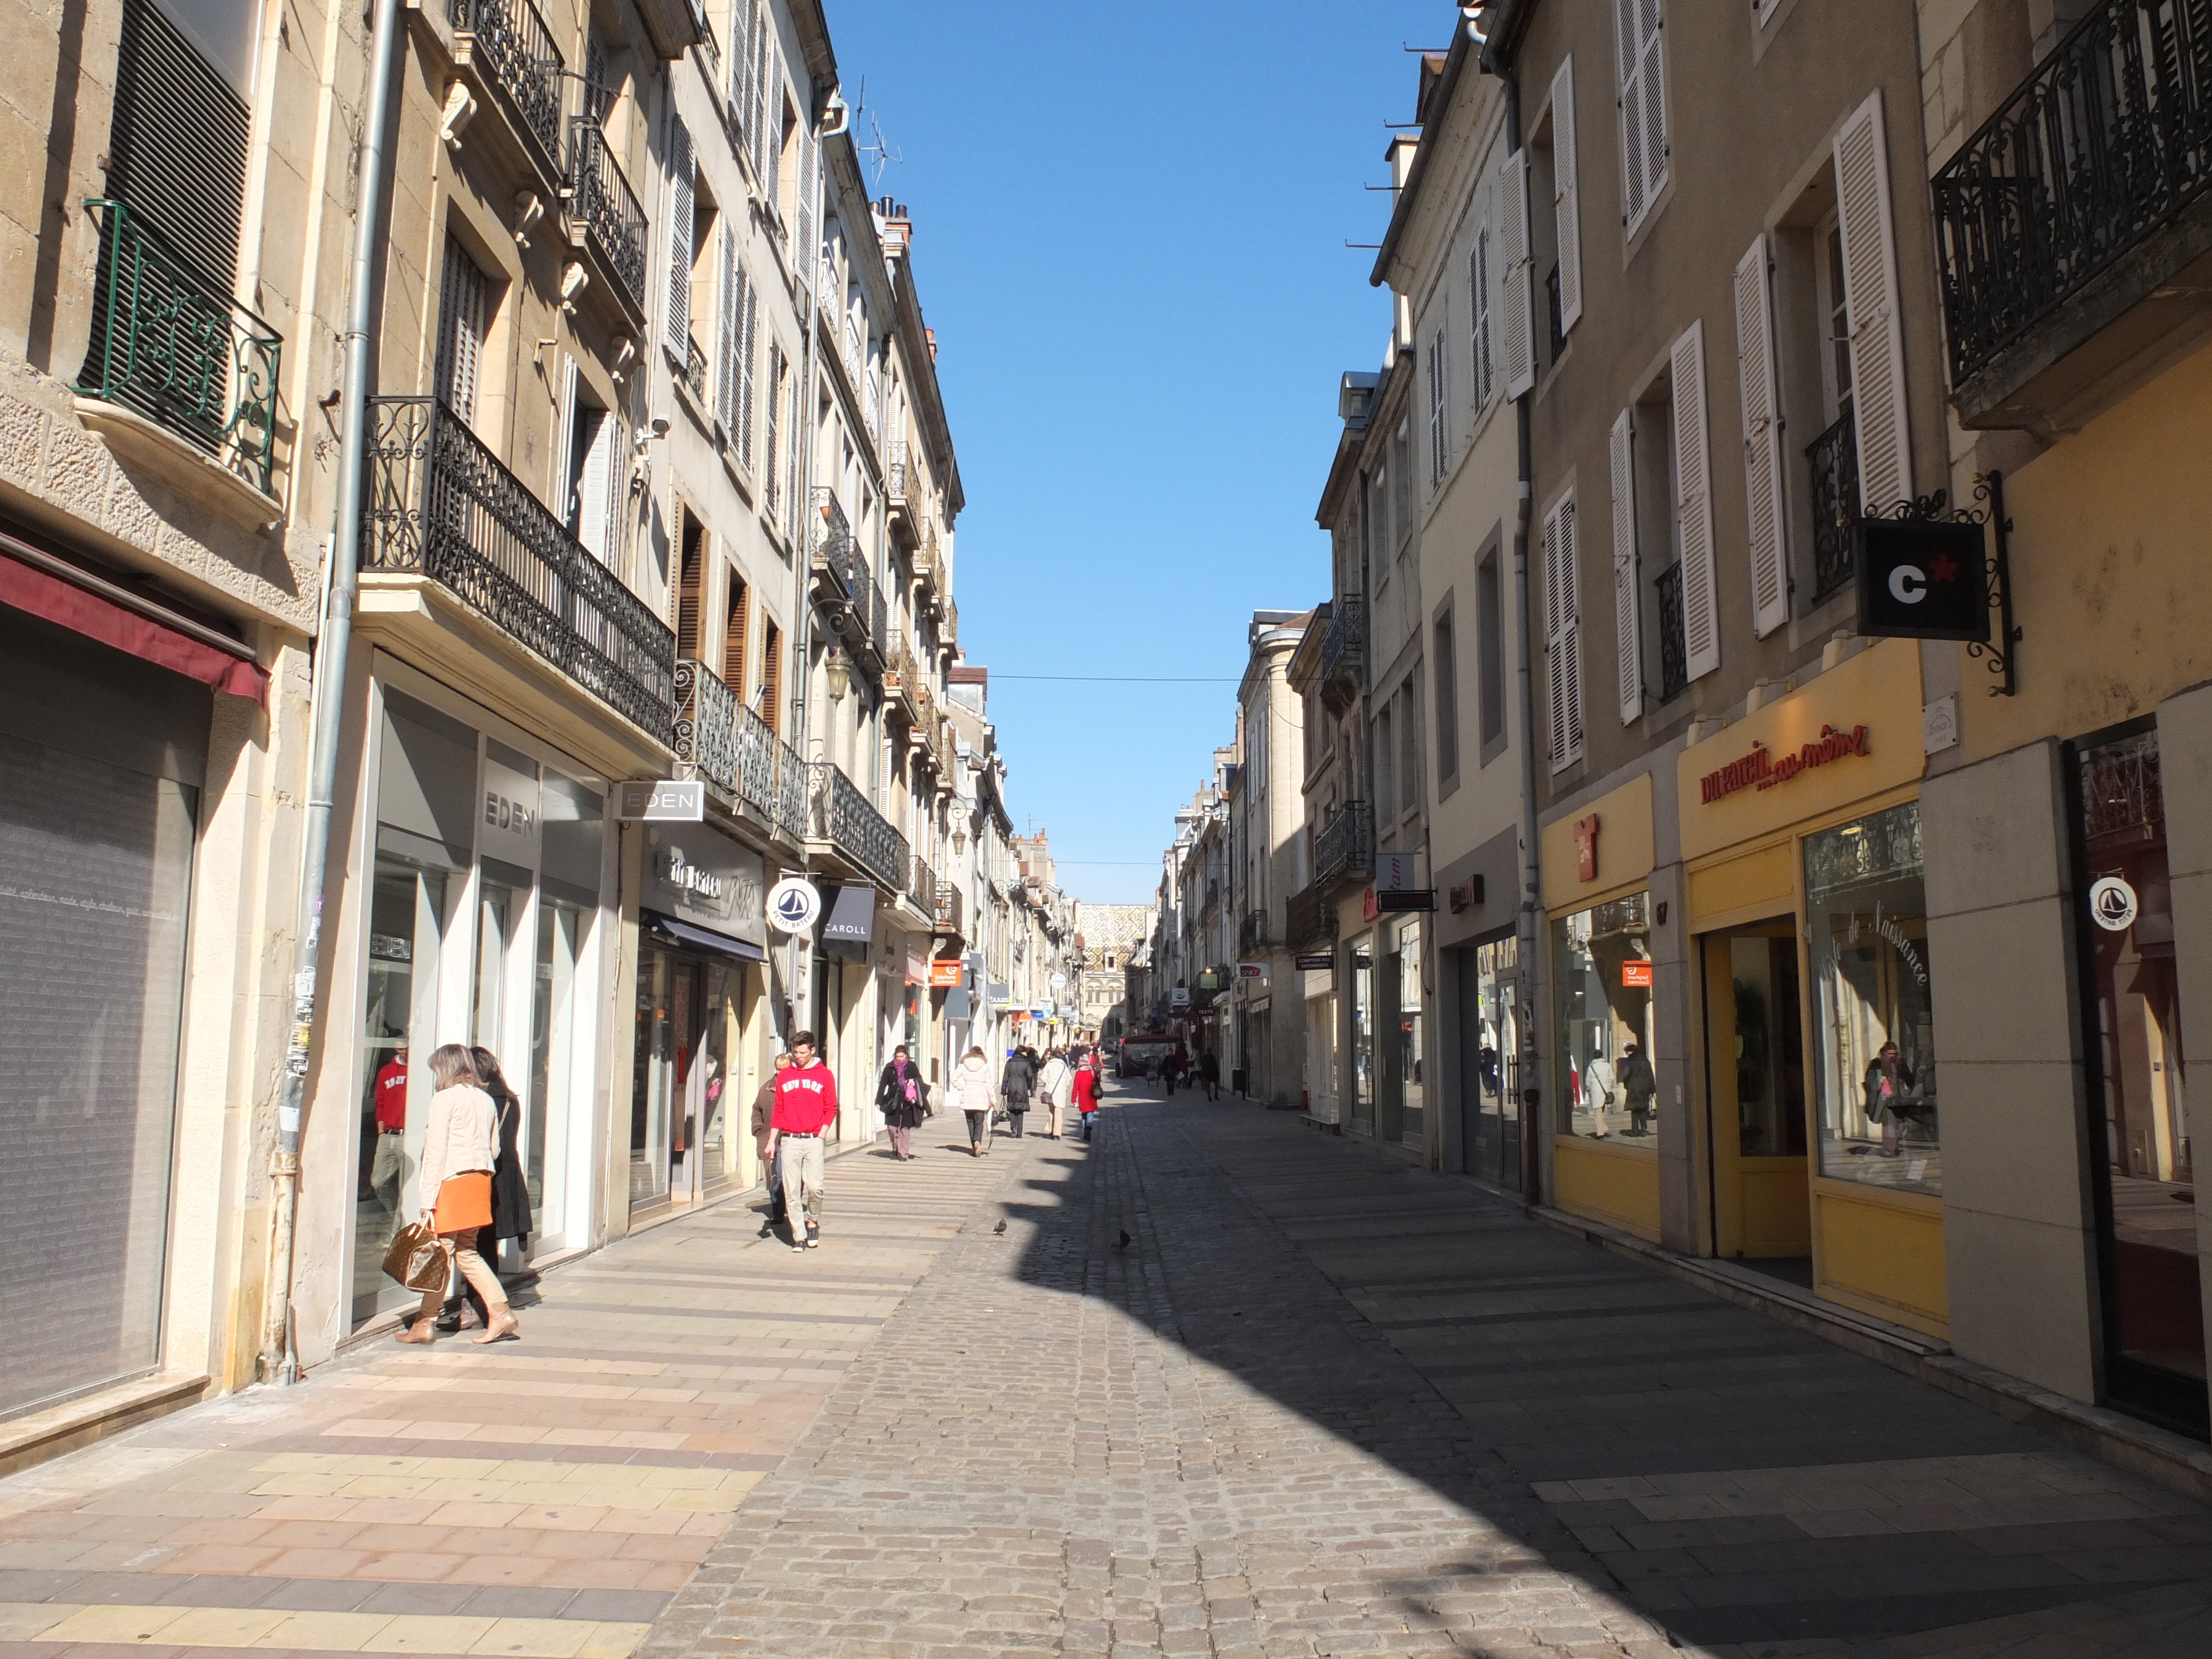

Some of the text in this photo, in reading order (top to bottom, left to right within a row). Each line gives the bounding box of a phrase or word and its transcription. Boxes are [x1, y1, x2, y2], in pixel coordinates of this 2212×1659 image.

[628, 794, 693, 808] EDEN
[486, 791, 535, 837] EDEN
[773, 910, 815, 928] PETIT BATEAU
[825, 924, 866, 935] CAROLL
[1849, 911, 1860, 943] de
[1868, 900, 1927, 986] Naissance
[782, 1079, 823, 1094] NEW YORK
